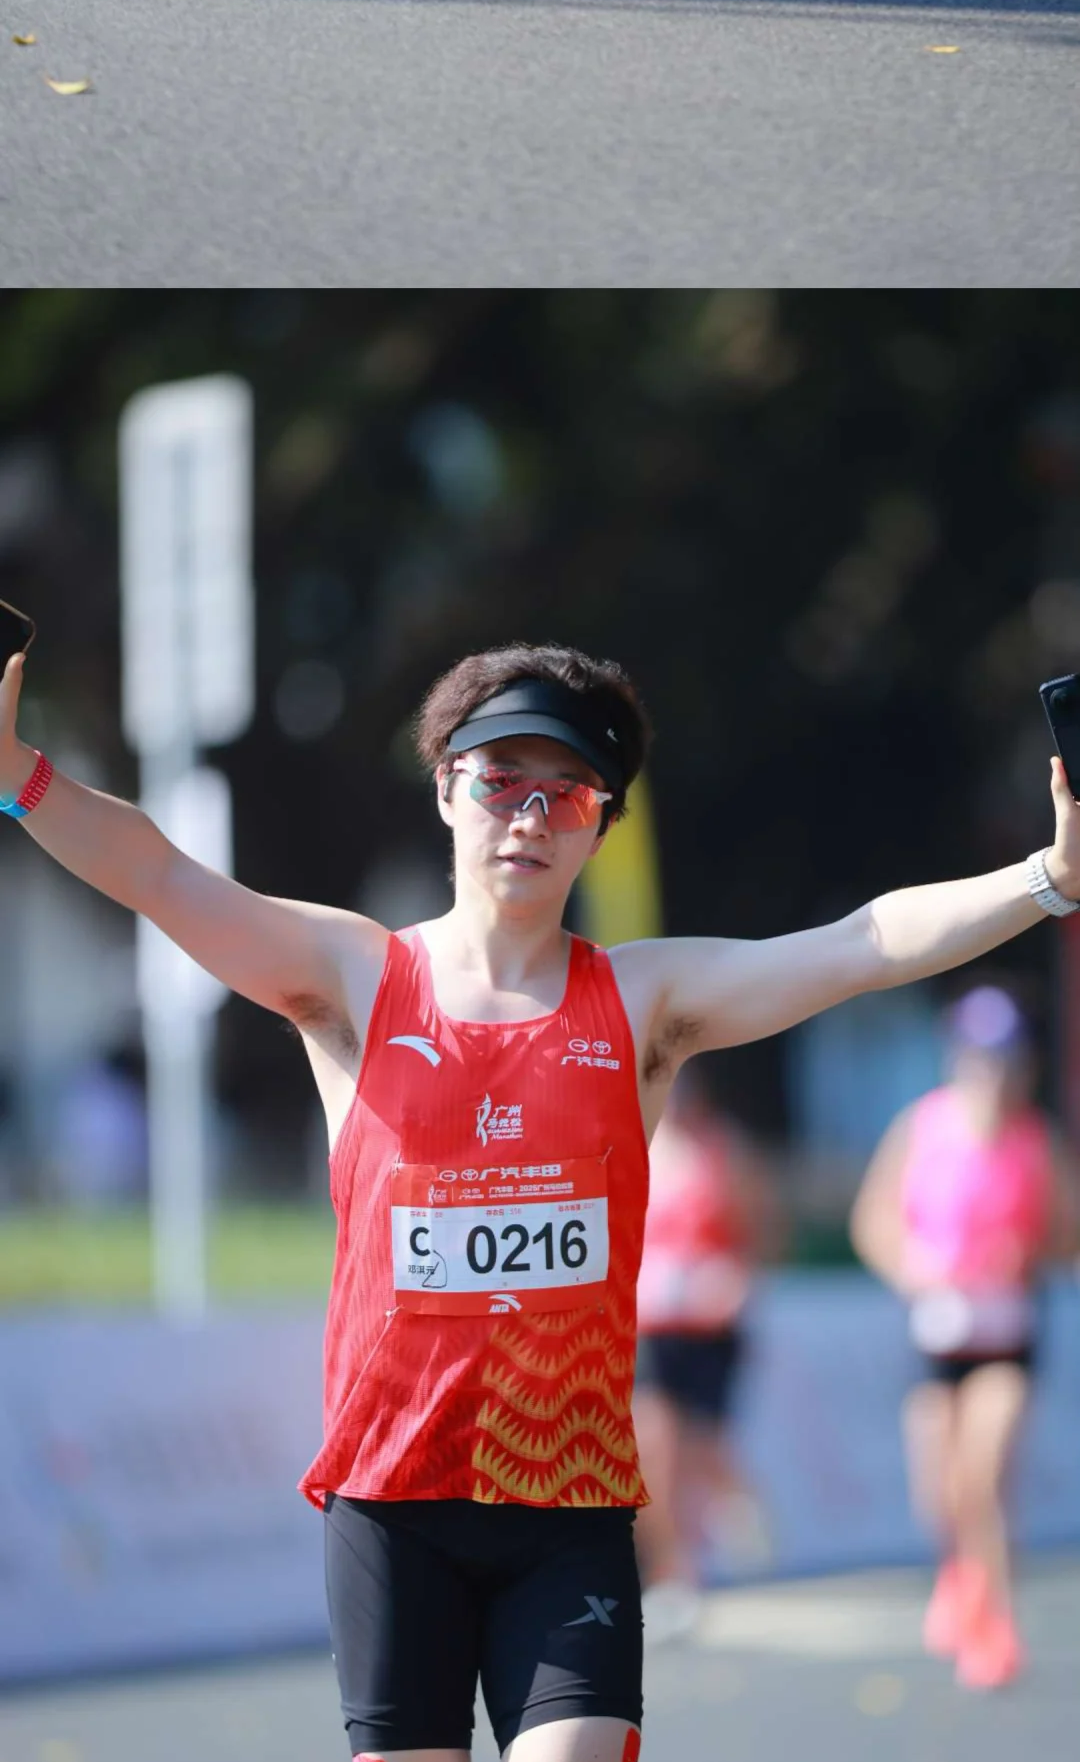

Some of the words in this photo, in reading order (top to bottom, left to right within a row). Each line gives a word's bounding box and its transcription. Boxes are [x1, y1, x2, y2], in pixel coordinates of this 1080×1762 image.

[560, 1055, 620, 1070] 广汽丰田
[493, 1104, 523, 1118] 广州
[479, 1163, 562, 1182] 广汽丰田
[410, 1226, 431, 1257] C
[466, 1219, 588, 1274] 0216
